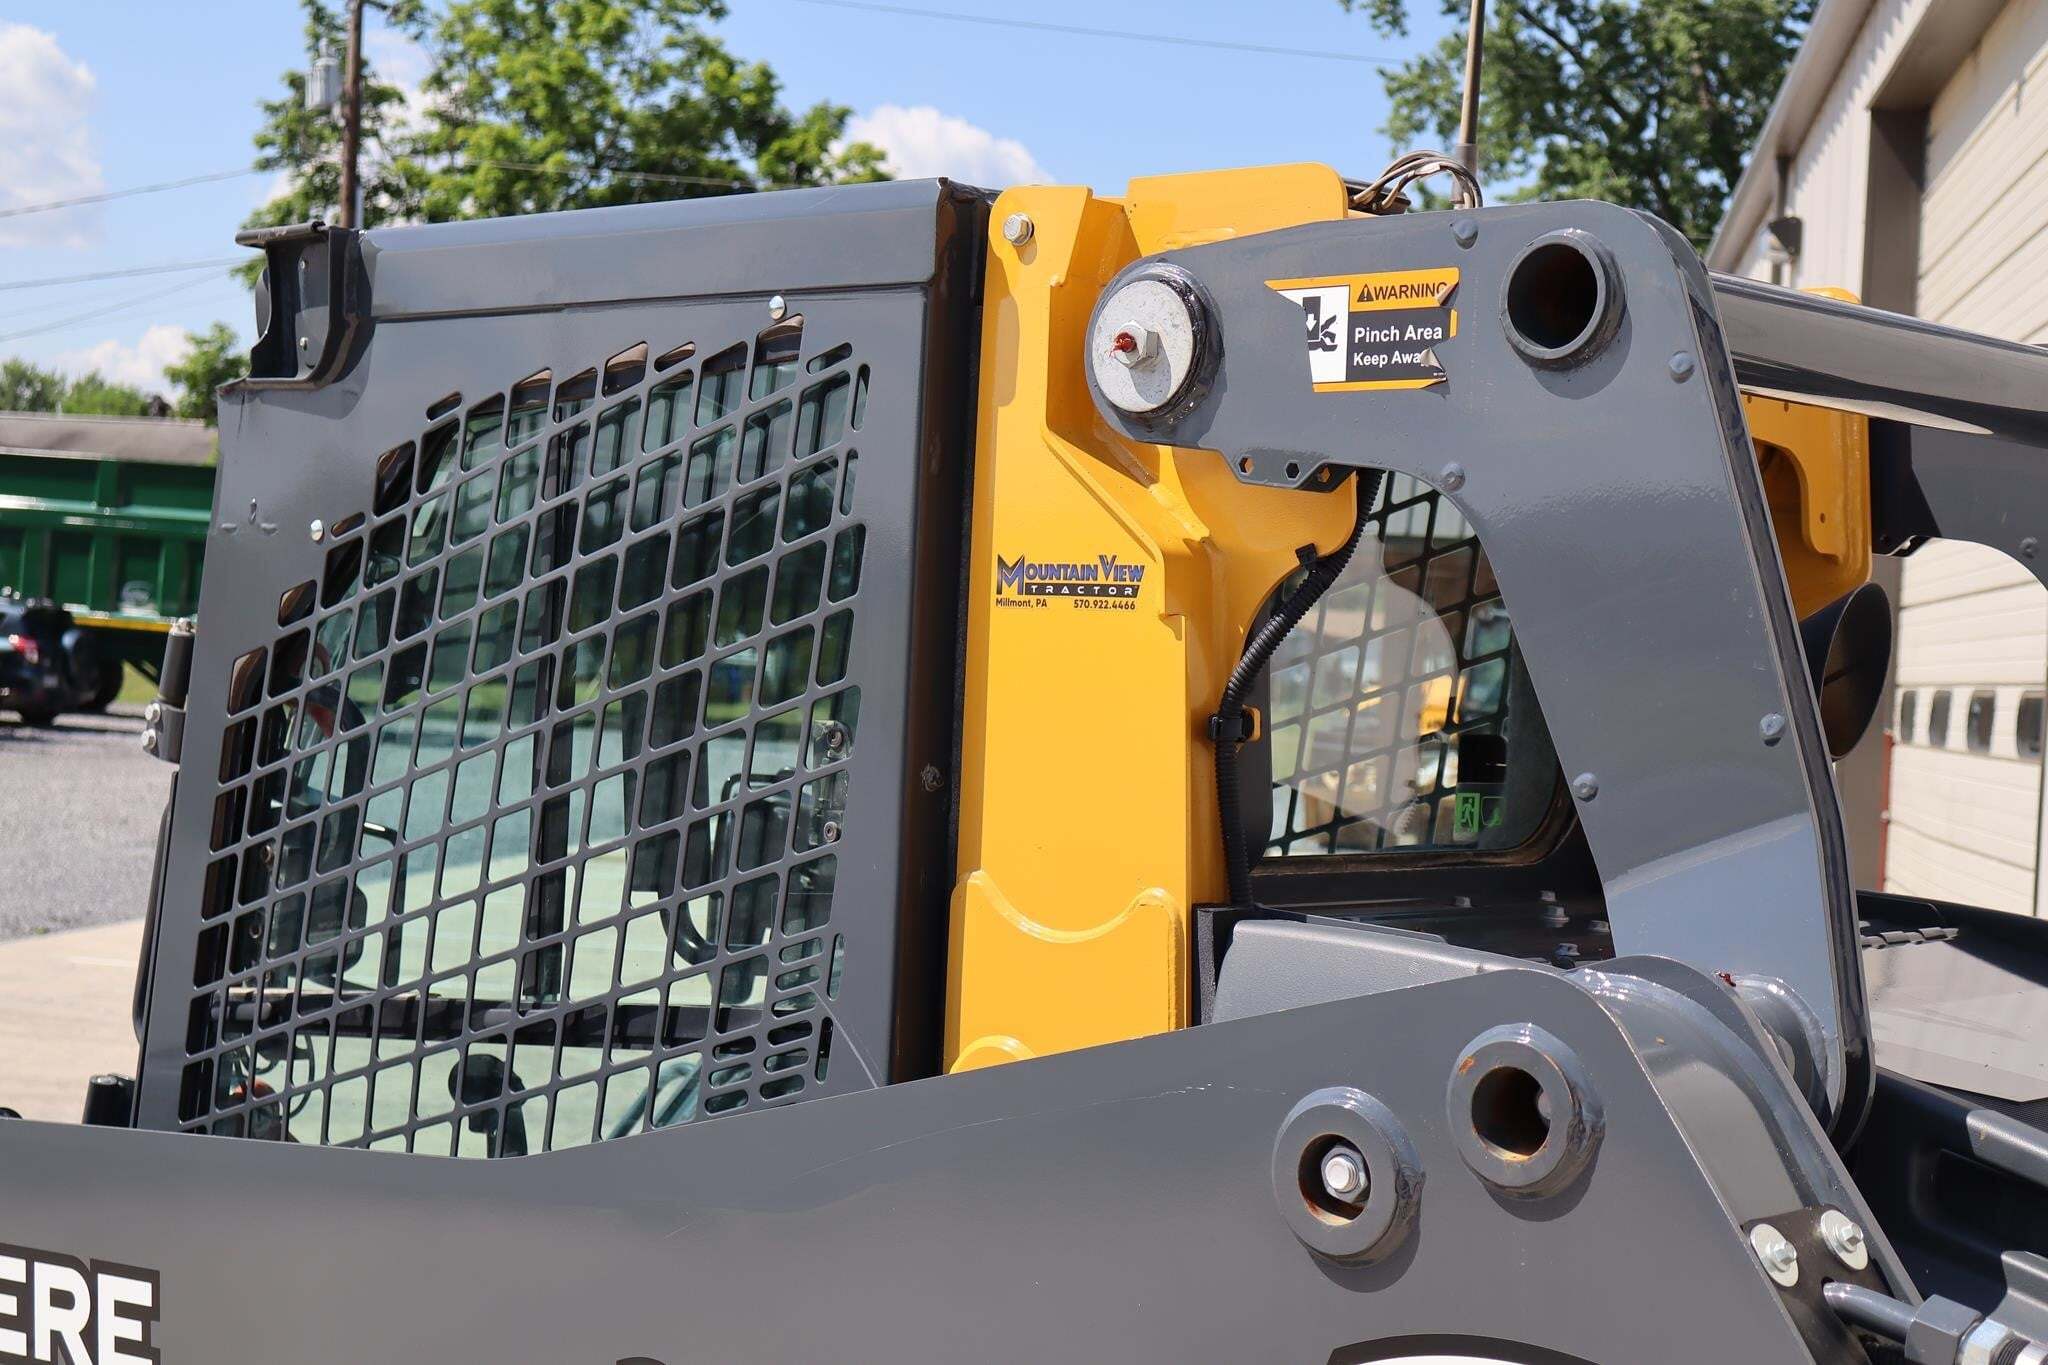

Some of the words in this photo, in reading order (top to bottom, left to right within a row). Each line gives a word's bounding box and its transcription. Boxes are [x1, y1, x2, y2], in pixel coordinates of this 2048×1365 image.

[1354, 325, 1400, 343] Pinch
[1404, 324, 1443, 341] Area
[1353, 352, 1389, 368] Keep
[1391, 350, 1428, 367] Awa
[996, 554, 1098, 595] MOUNTAIN
[1099, 555, 1145, 582] VIEW
[1031, 585, 1133, 596] TRACTOR
[995, 598, 1034, 608] Millmont,
[1036, 599, 1047, 607] PA
[1074, 600, 1136, 610] 570.922.4466
